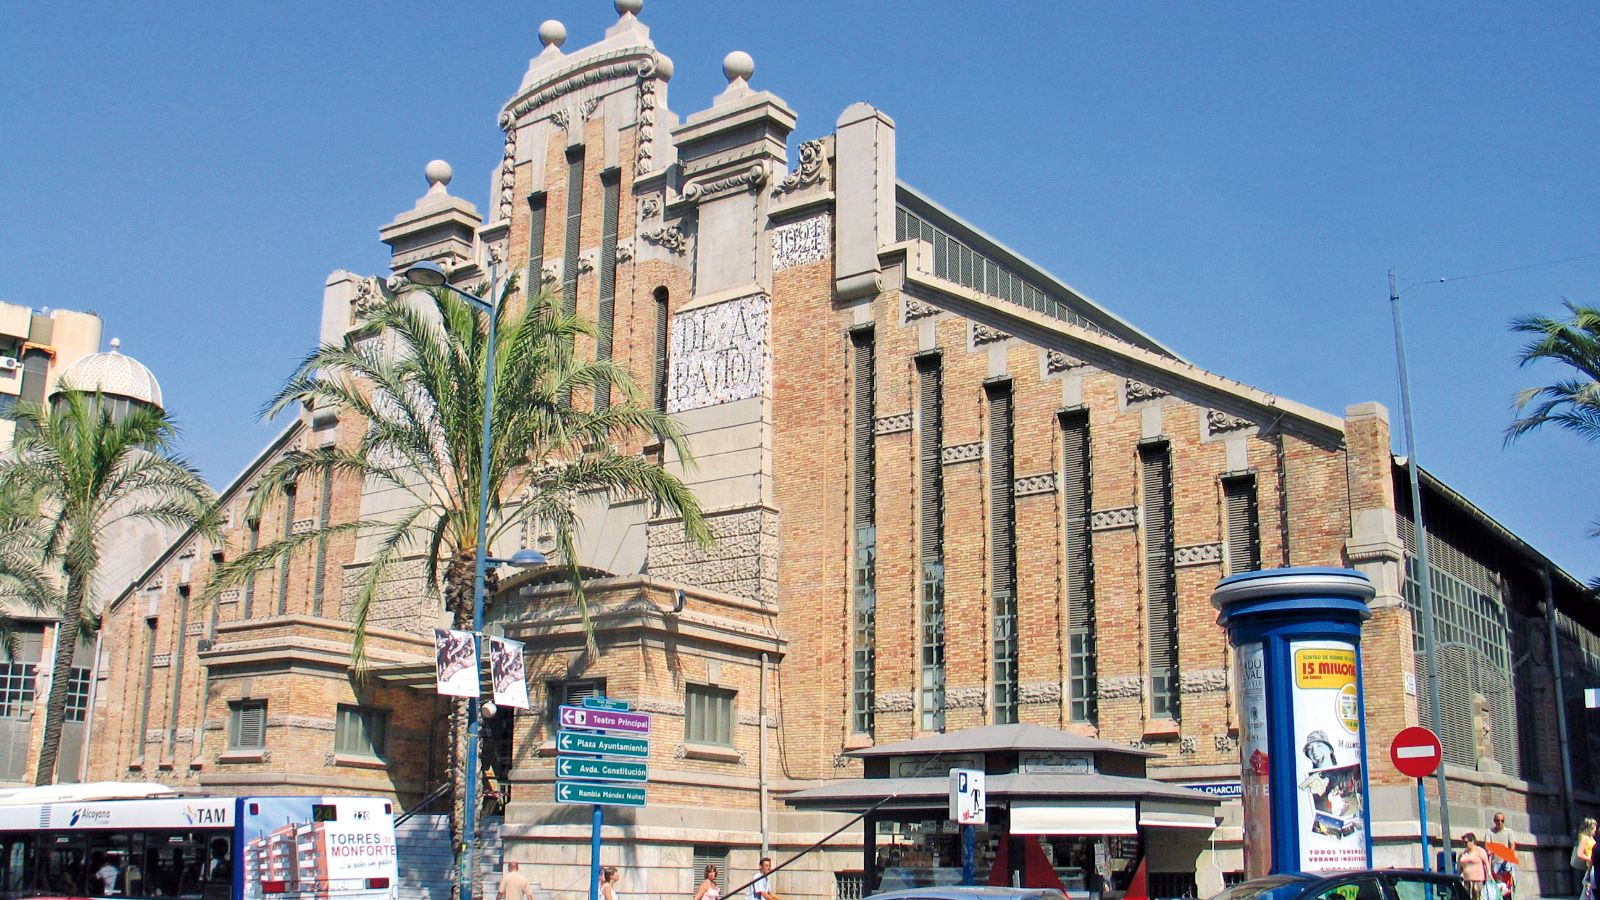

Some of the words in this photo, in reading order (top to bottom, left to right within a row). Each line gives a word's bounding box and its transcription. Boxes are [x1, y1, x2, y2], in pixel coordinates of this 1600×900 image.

[1302, 662, 1315, 675] 15
[593, 715, 616, 725] Teatro
[617, 718, 648, 729] Principal
[577, 739, 596, 748] Plaza
[599, 741, 648, 753] Ayuntamiento
[579, 765, 600, 774] Avda.
[602, 766, 646, 776] Constitución
[578, 790, 602, 798] Rambla
[602, 791, 625, 800] Méndez
[197, 808, 226, 824] TAM
[330, 833, 381, 845] TORRES
[331, 845, 396, 857] MONFORTE
